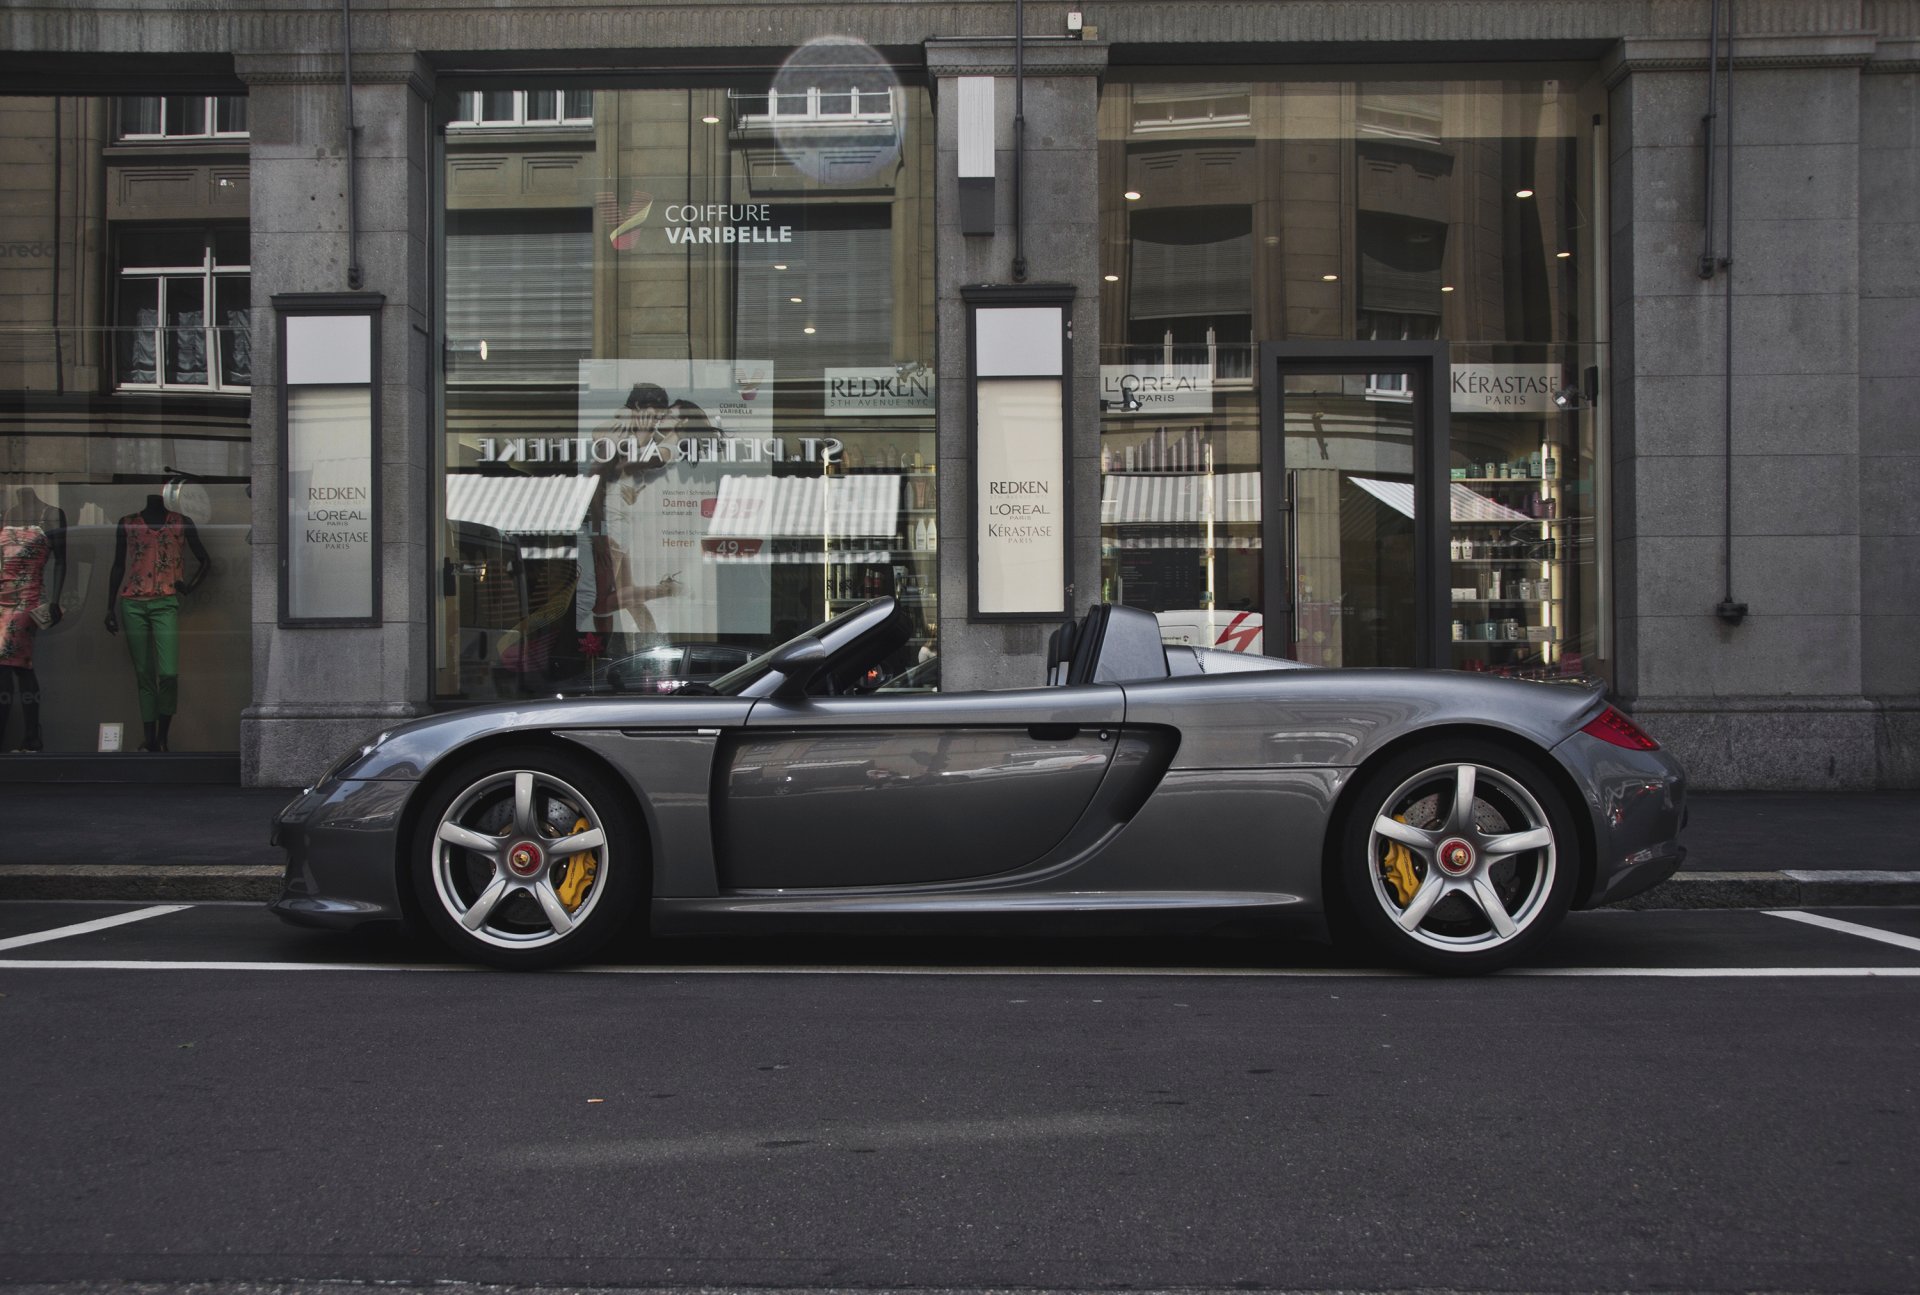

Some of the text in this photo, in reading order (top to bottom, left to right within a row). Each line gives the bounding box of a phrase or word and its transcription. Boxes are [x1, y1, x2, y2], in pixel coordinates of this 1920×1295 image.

[665, 204, 770, 222] COIFFURE
[665, 226, 792, 244] VARIBELLE
[831, 376, 928, 398] REDKEN
[1452, 371, 1558, 394] KÉRASTASE
[857, 399, 902, 407] AVENUE
[907, 398, 928, 407] NYC
[1138, 394, 1175, 402] PARIS
[1485, 395, 1526, 405] PARIS
[308, 487, 366, 500] REDKEN
[990, 481, 1048, 494] REDKEN
[662, 498, 698, 508] Damen
[306, 529, 369, 543] KÉRASTASE
[988, 523, 1052, 537] KÉRASTASE
[662, 538, 695, 548] Herren
